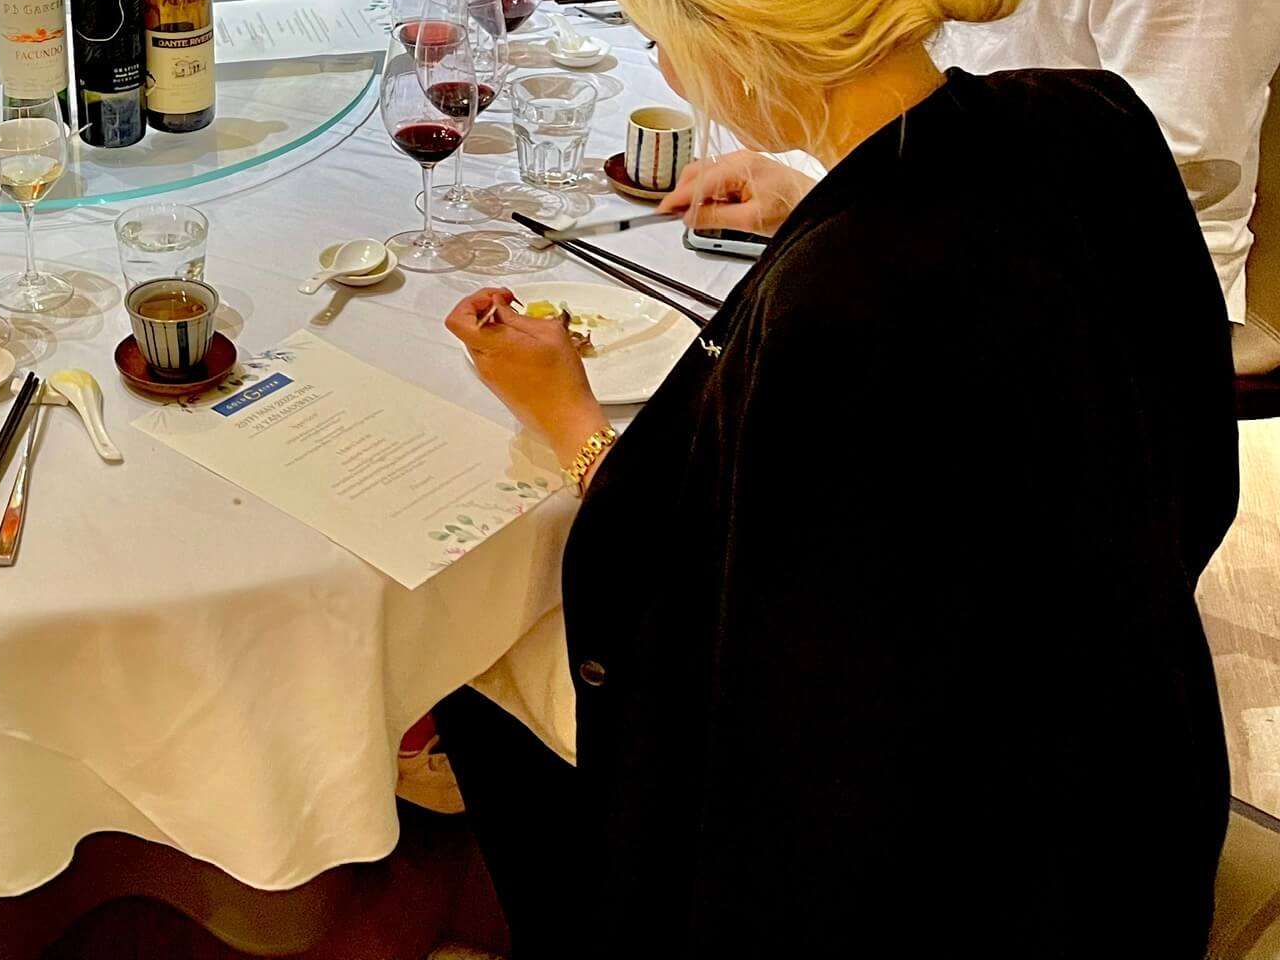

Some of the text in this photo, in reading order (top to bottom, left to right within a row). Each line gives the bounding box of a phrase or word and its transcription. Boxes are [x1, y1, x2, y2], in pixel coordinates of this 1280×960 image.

[158, 39, 189, 48] DANTE
[15, 44, 64, 60] FACUNDO
[256, 401, 276, 417] MAY
[279, 394, 319, 417] MAXWELL
